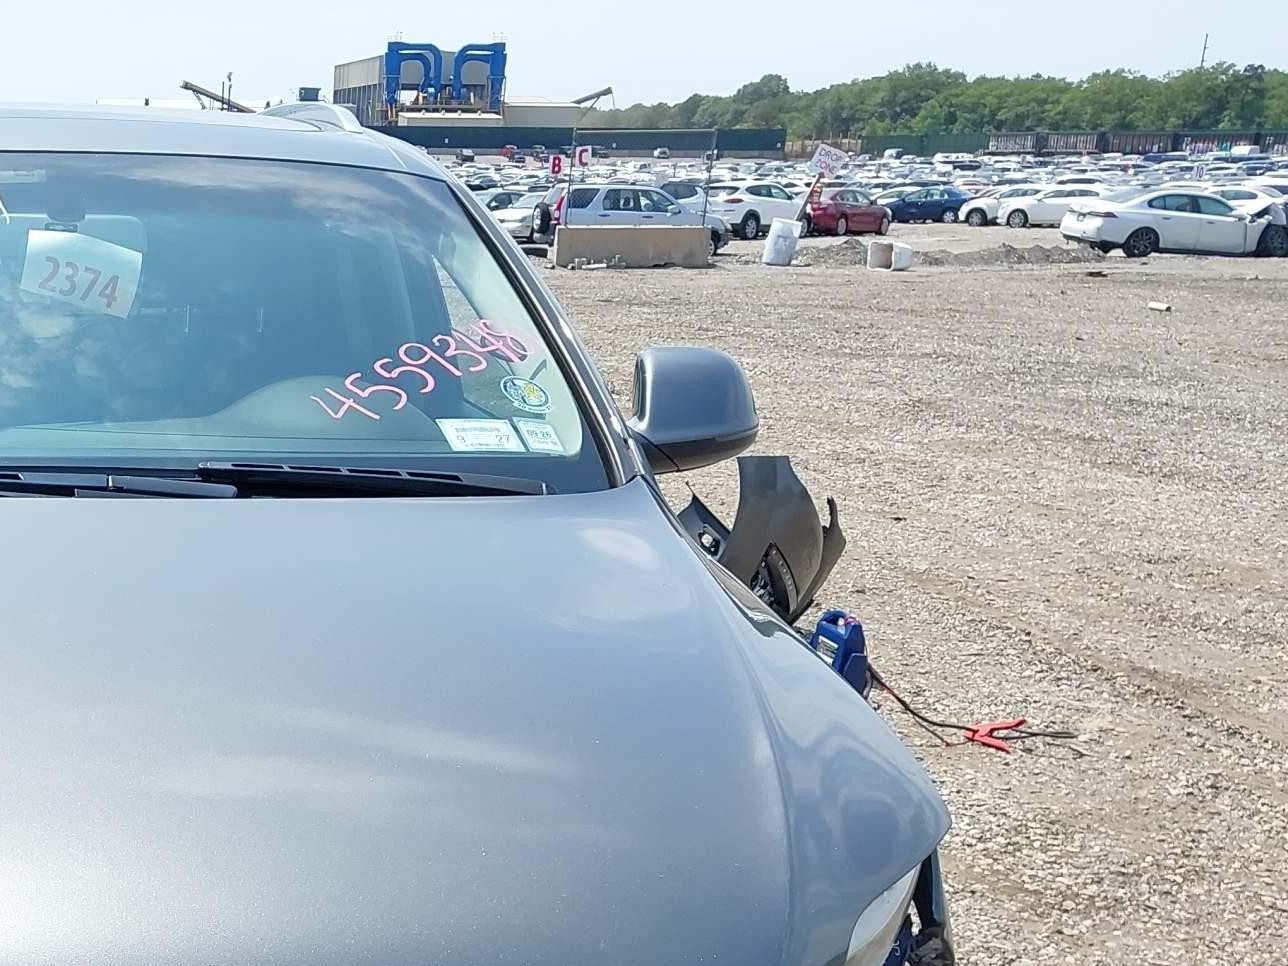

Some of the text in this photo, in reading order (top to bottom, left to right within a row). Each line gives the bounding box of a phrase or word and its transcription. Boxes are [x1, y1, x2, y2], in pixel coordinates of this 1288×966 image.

[578, 148, 589, 167] C
[819, 148, 843, 162] DROP
[551, 156, 562, 174] B
[815, 158, 838, 175] ZONE
[38, 255, 120, 309] 2374
[495, 433, 511, 444] 27
